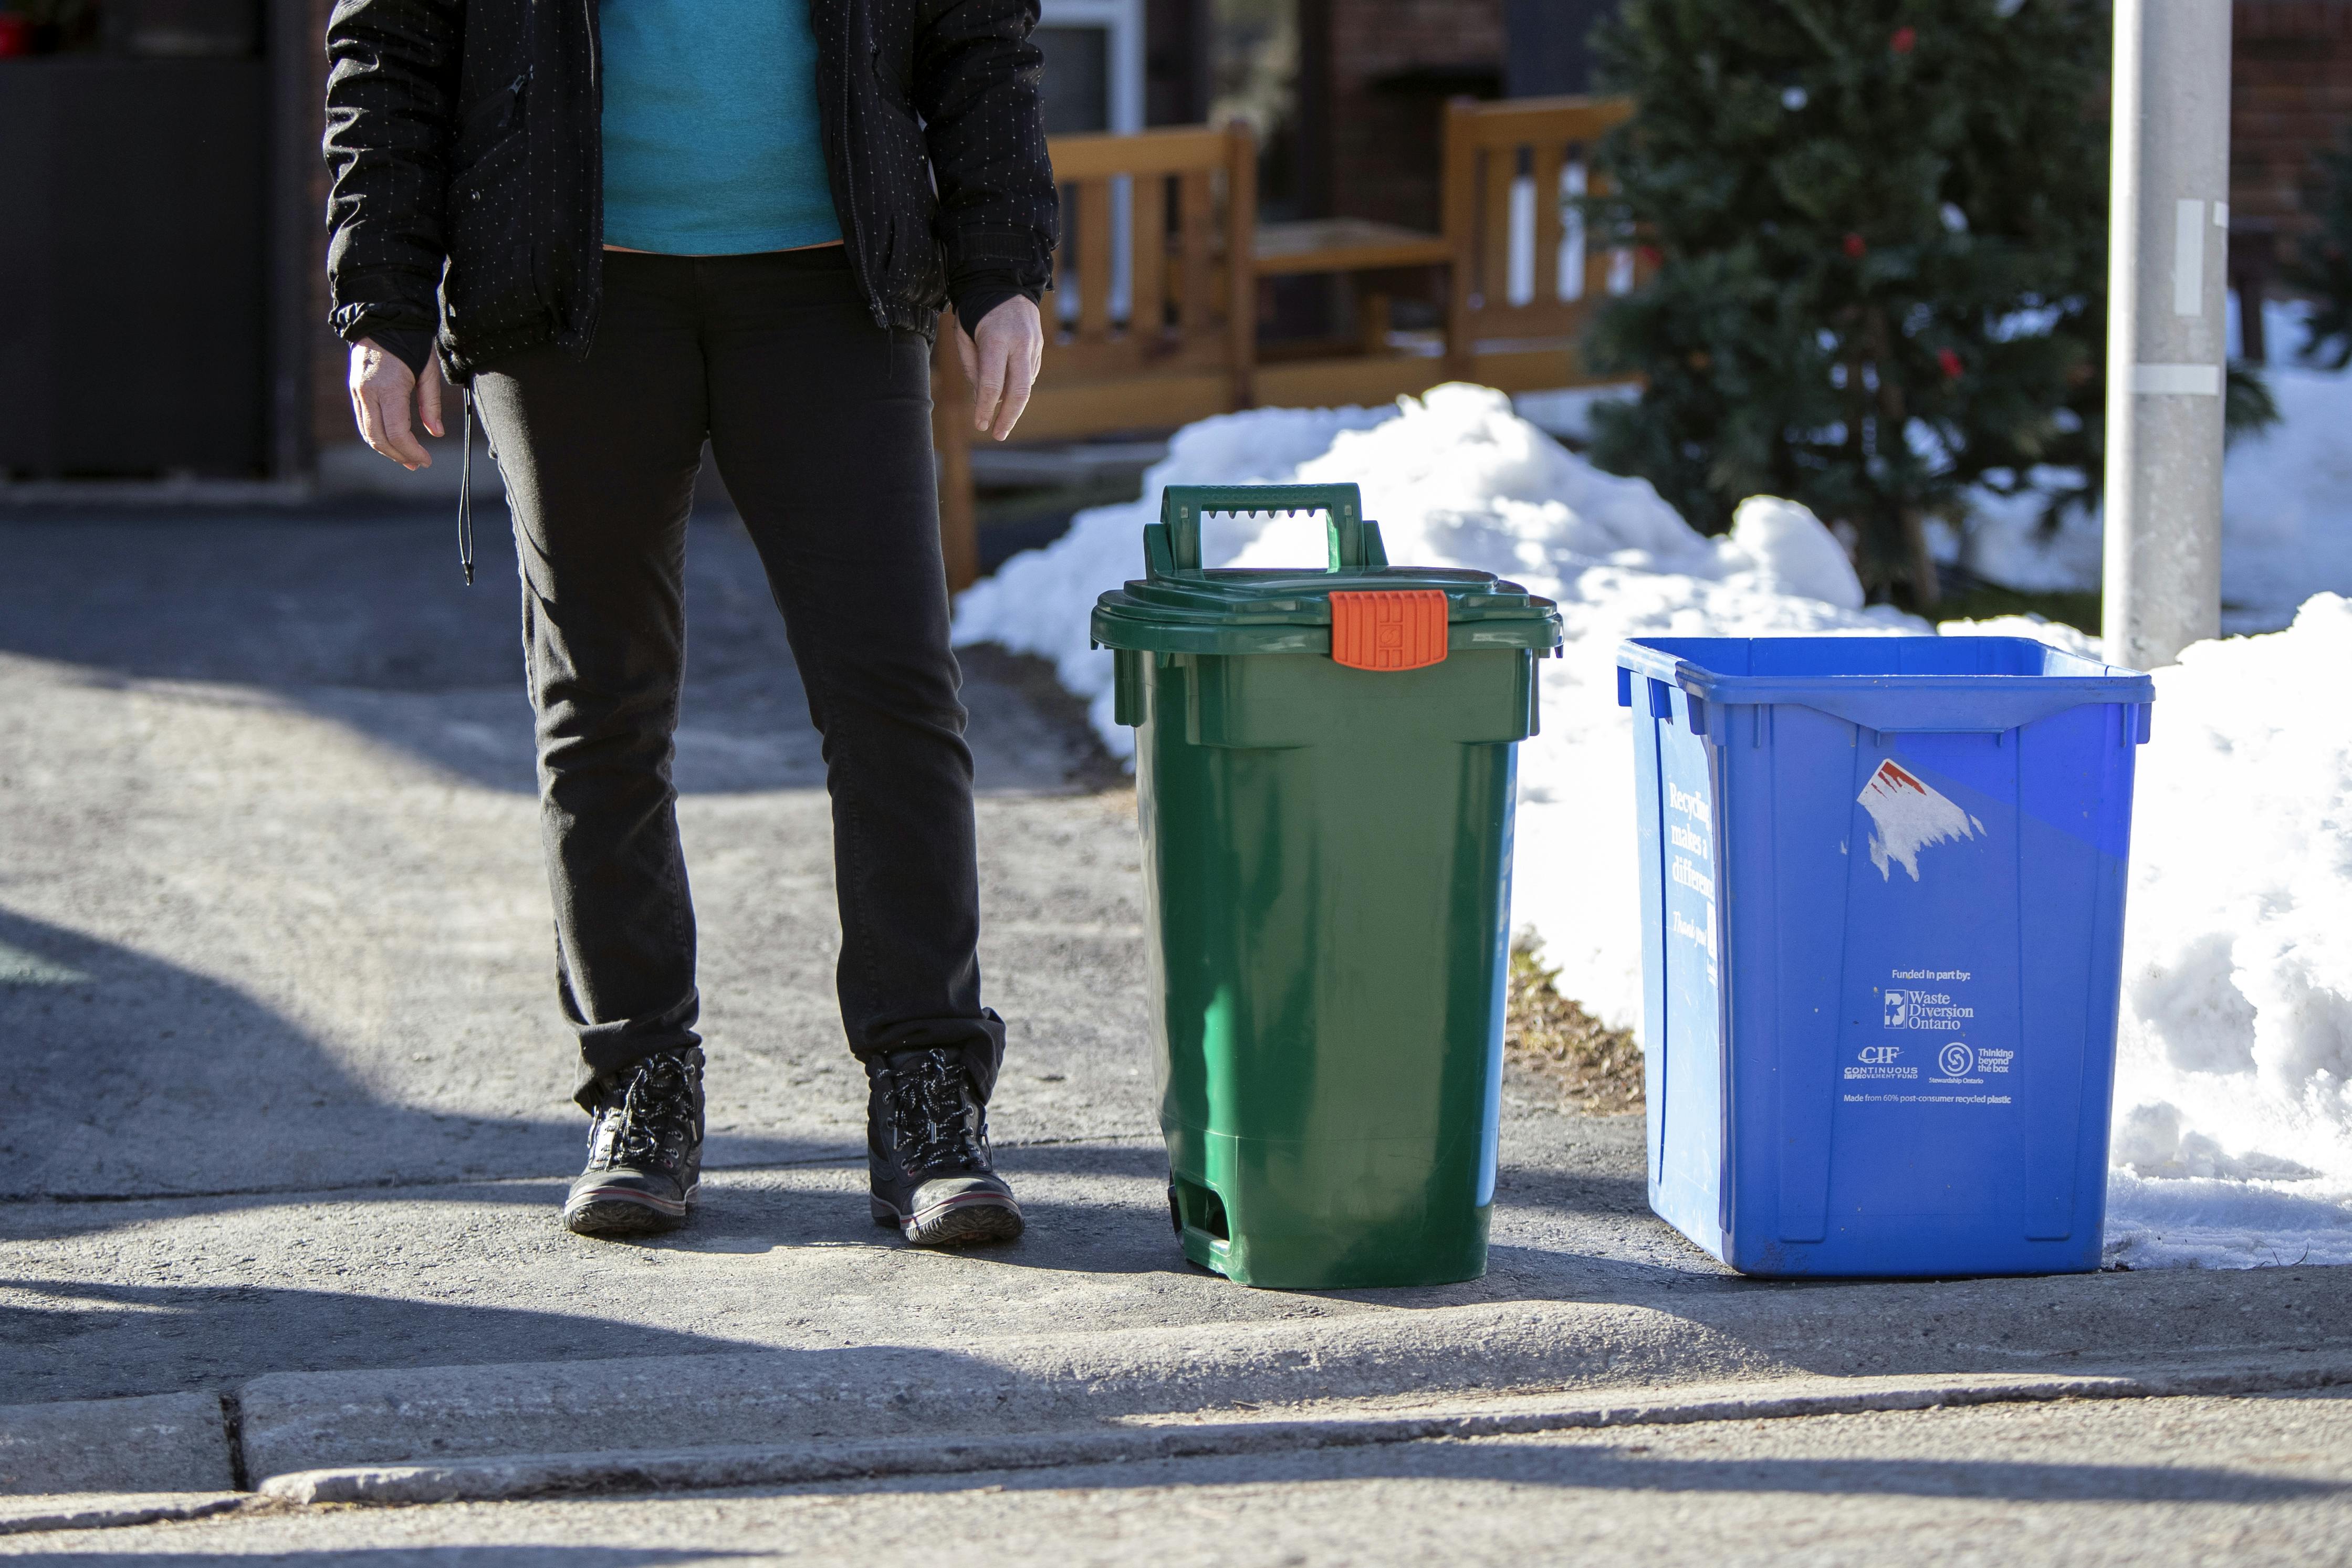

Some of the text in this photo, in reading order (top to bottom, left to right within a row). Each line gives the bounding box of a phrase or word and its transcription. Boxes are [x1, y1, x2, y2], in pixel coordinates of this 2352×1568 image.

[1671, 823, 1702, 856] makes
[1672, 911, 1696, 938] Thank
[1892, 969, 1925, 979] Funded
[1936, 970, 1955, 981] part
[1956, 970, 1971, 981] by:
[1909, 991, 1950, 1004] Waste
[1908, 1003, 1974, 1018] Diversion
[1908, 1017, 1961, 1030] Ontario
[1859, 1047, 1900, 1064] CIF
[1978, 1048, 2014, 1059] Thinking
[1978, 1057, 2009, 1066] beyond
[1900, 1095, 1953, 1103] post-consumer
[1955, 1095, 1986, 1104] recycled
[1987, 1095, 2012, 1104] plastic
